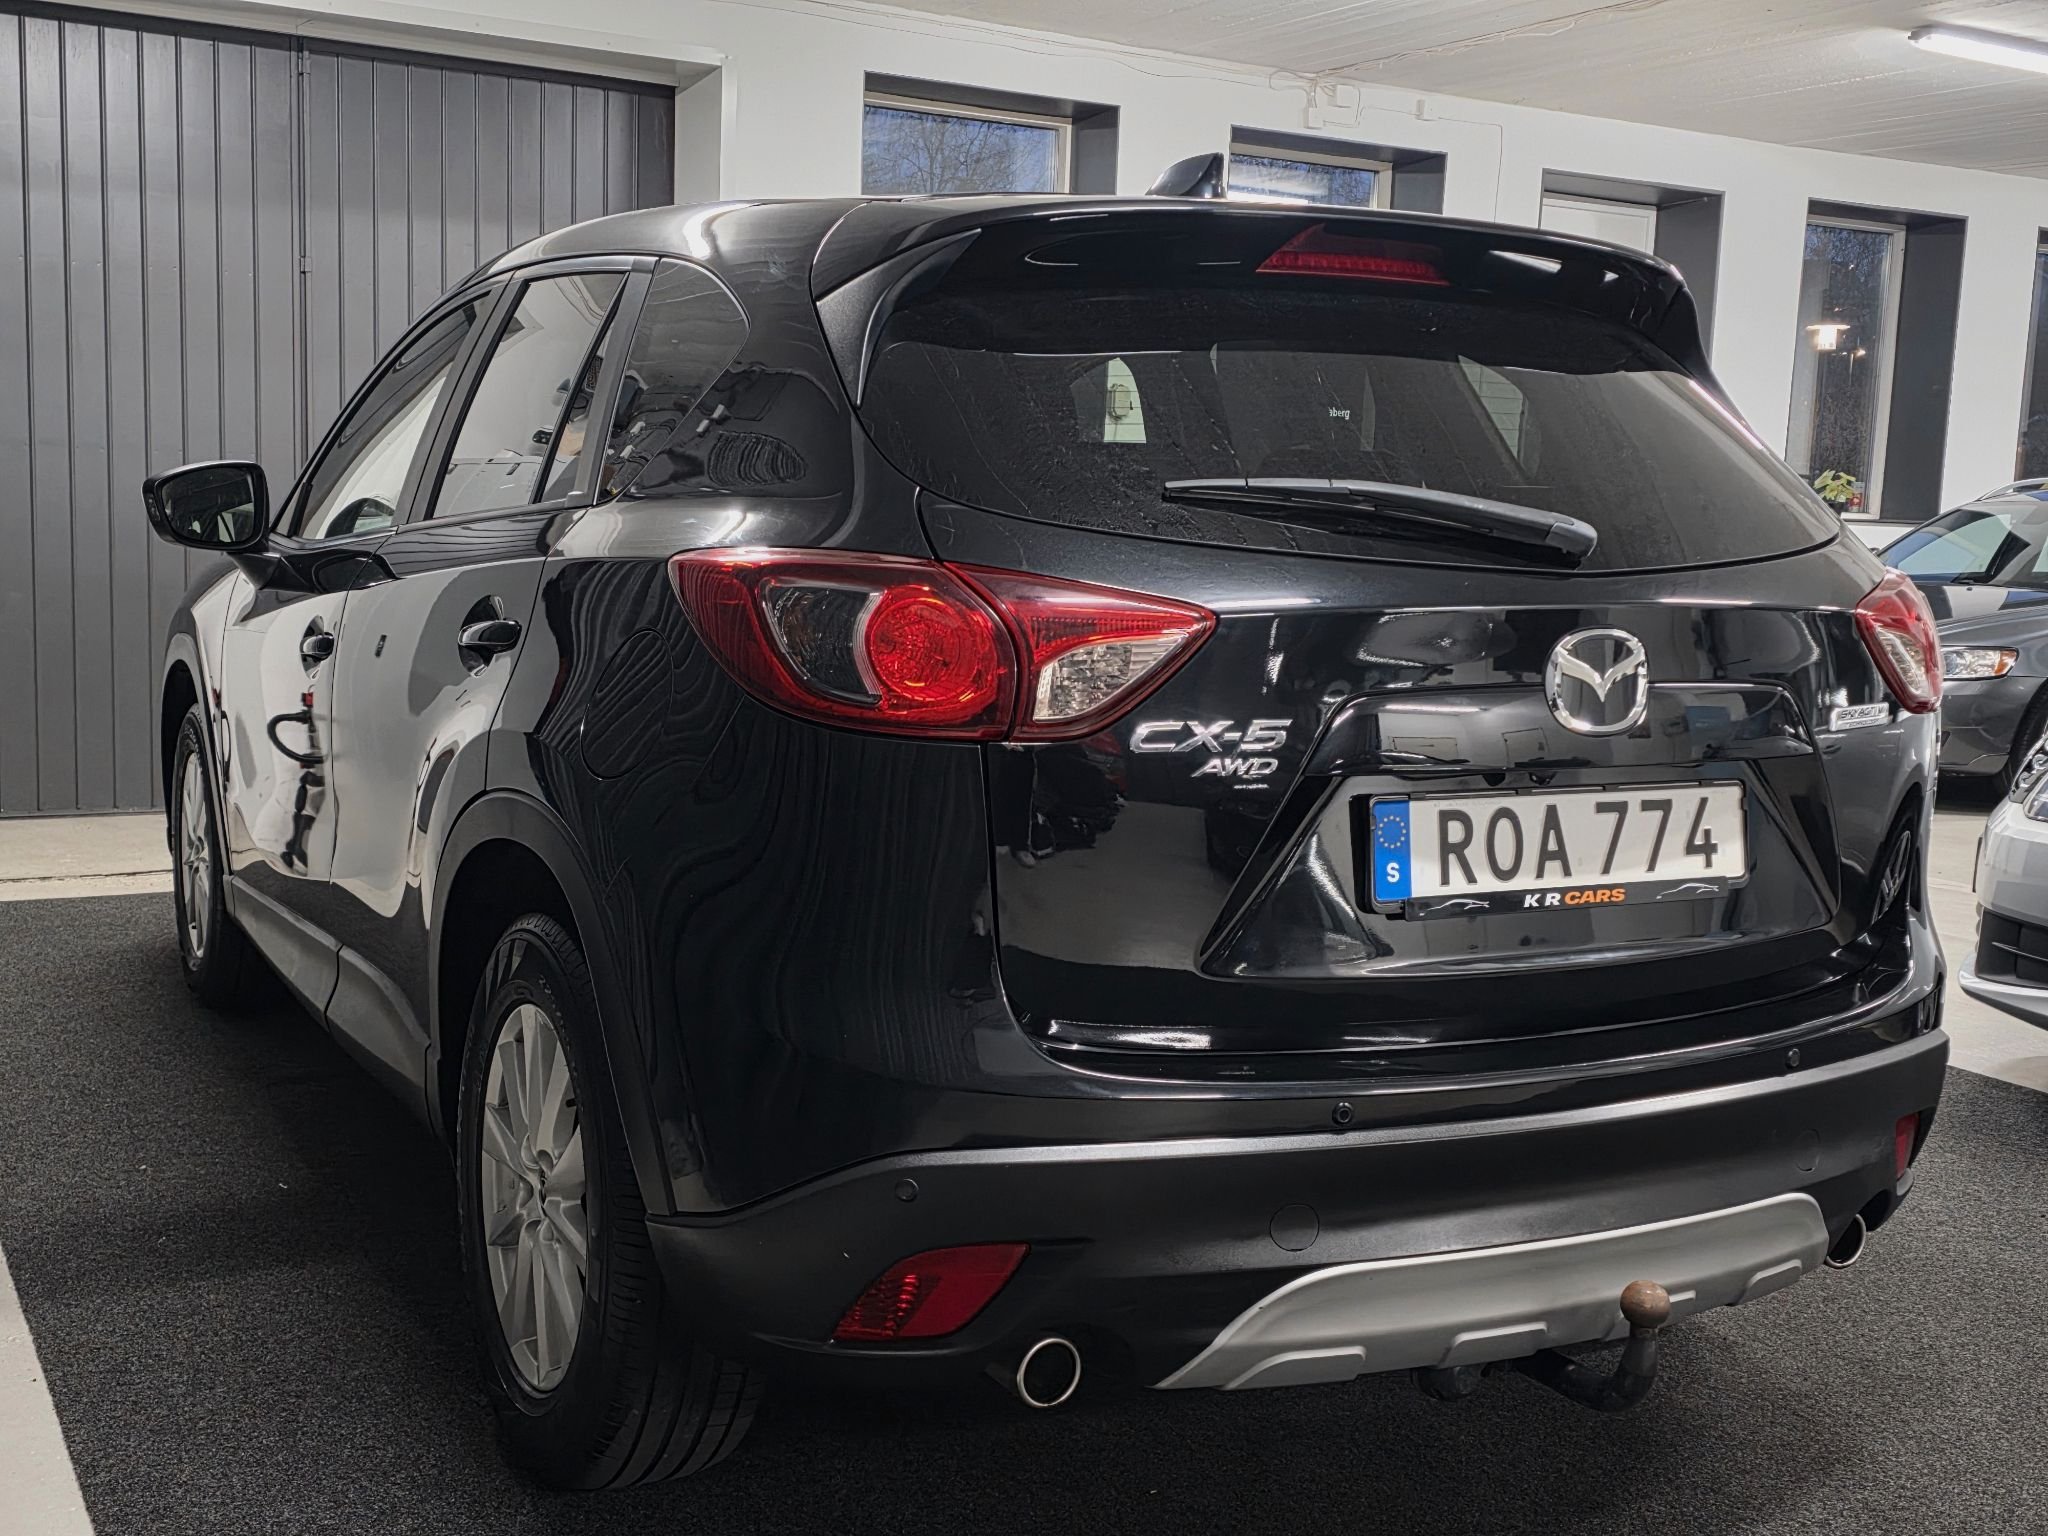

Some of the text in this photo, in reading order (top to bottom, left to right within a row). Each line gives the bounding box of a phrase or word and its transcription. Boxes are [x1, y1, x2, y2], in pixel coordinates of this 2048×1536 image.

[1129, 718, 1293, 753] CX-5
[1191, 757, 1278, 777] AWD
[1437, 796, 1719, 887] ROA 774
[1386, 862, 1400, 883] S
[1564, 888, 1626, 905] CARS
